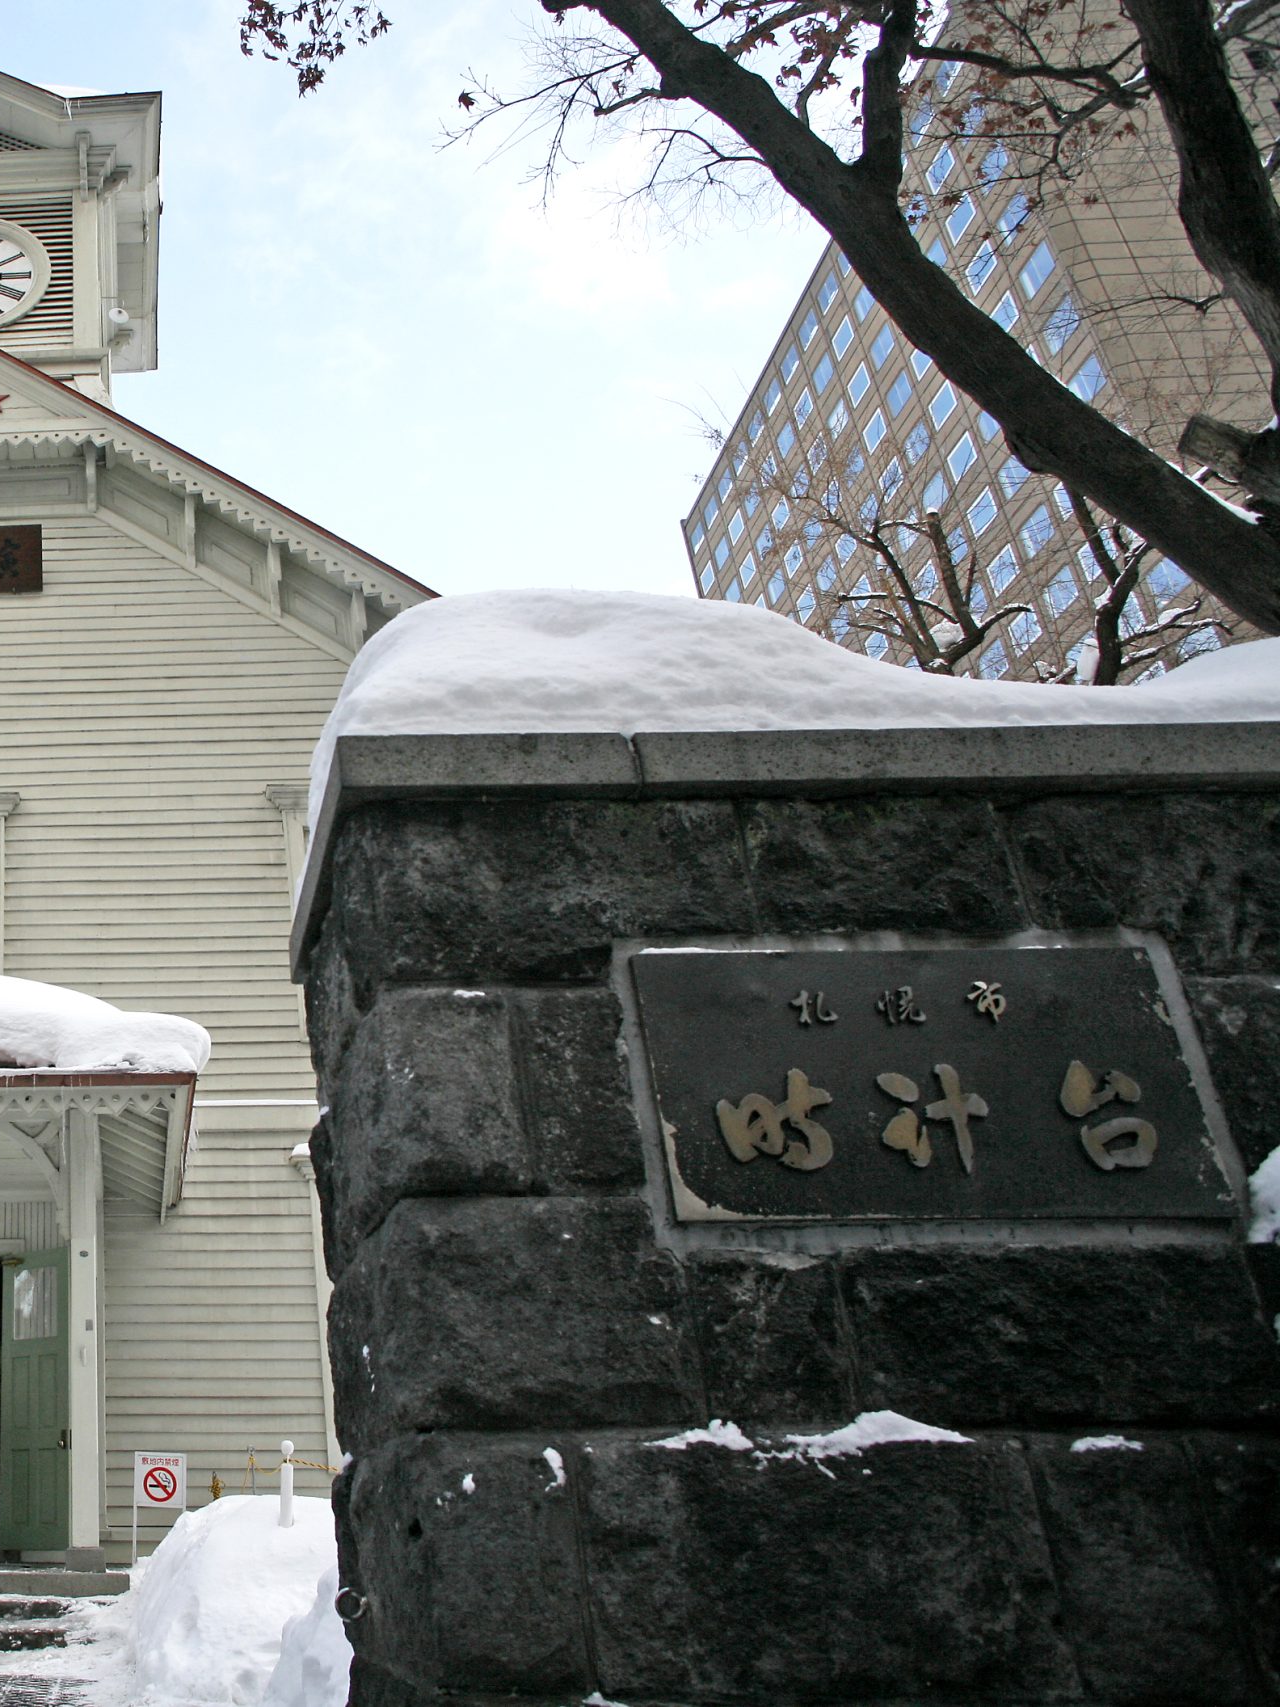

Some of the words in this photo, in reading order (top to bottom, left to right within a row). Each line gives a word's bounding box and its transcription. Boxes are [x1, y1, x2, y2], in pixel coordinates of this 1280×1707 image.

[789, 980, 1008, 1026] 札幌市
[715, 1060, 1158, 1175] 時計台
